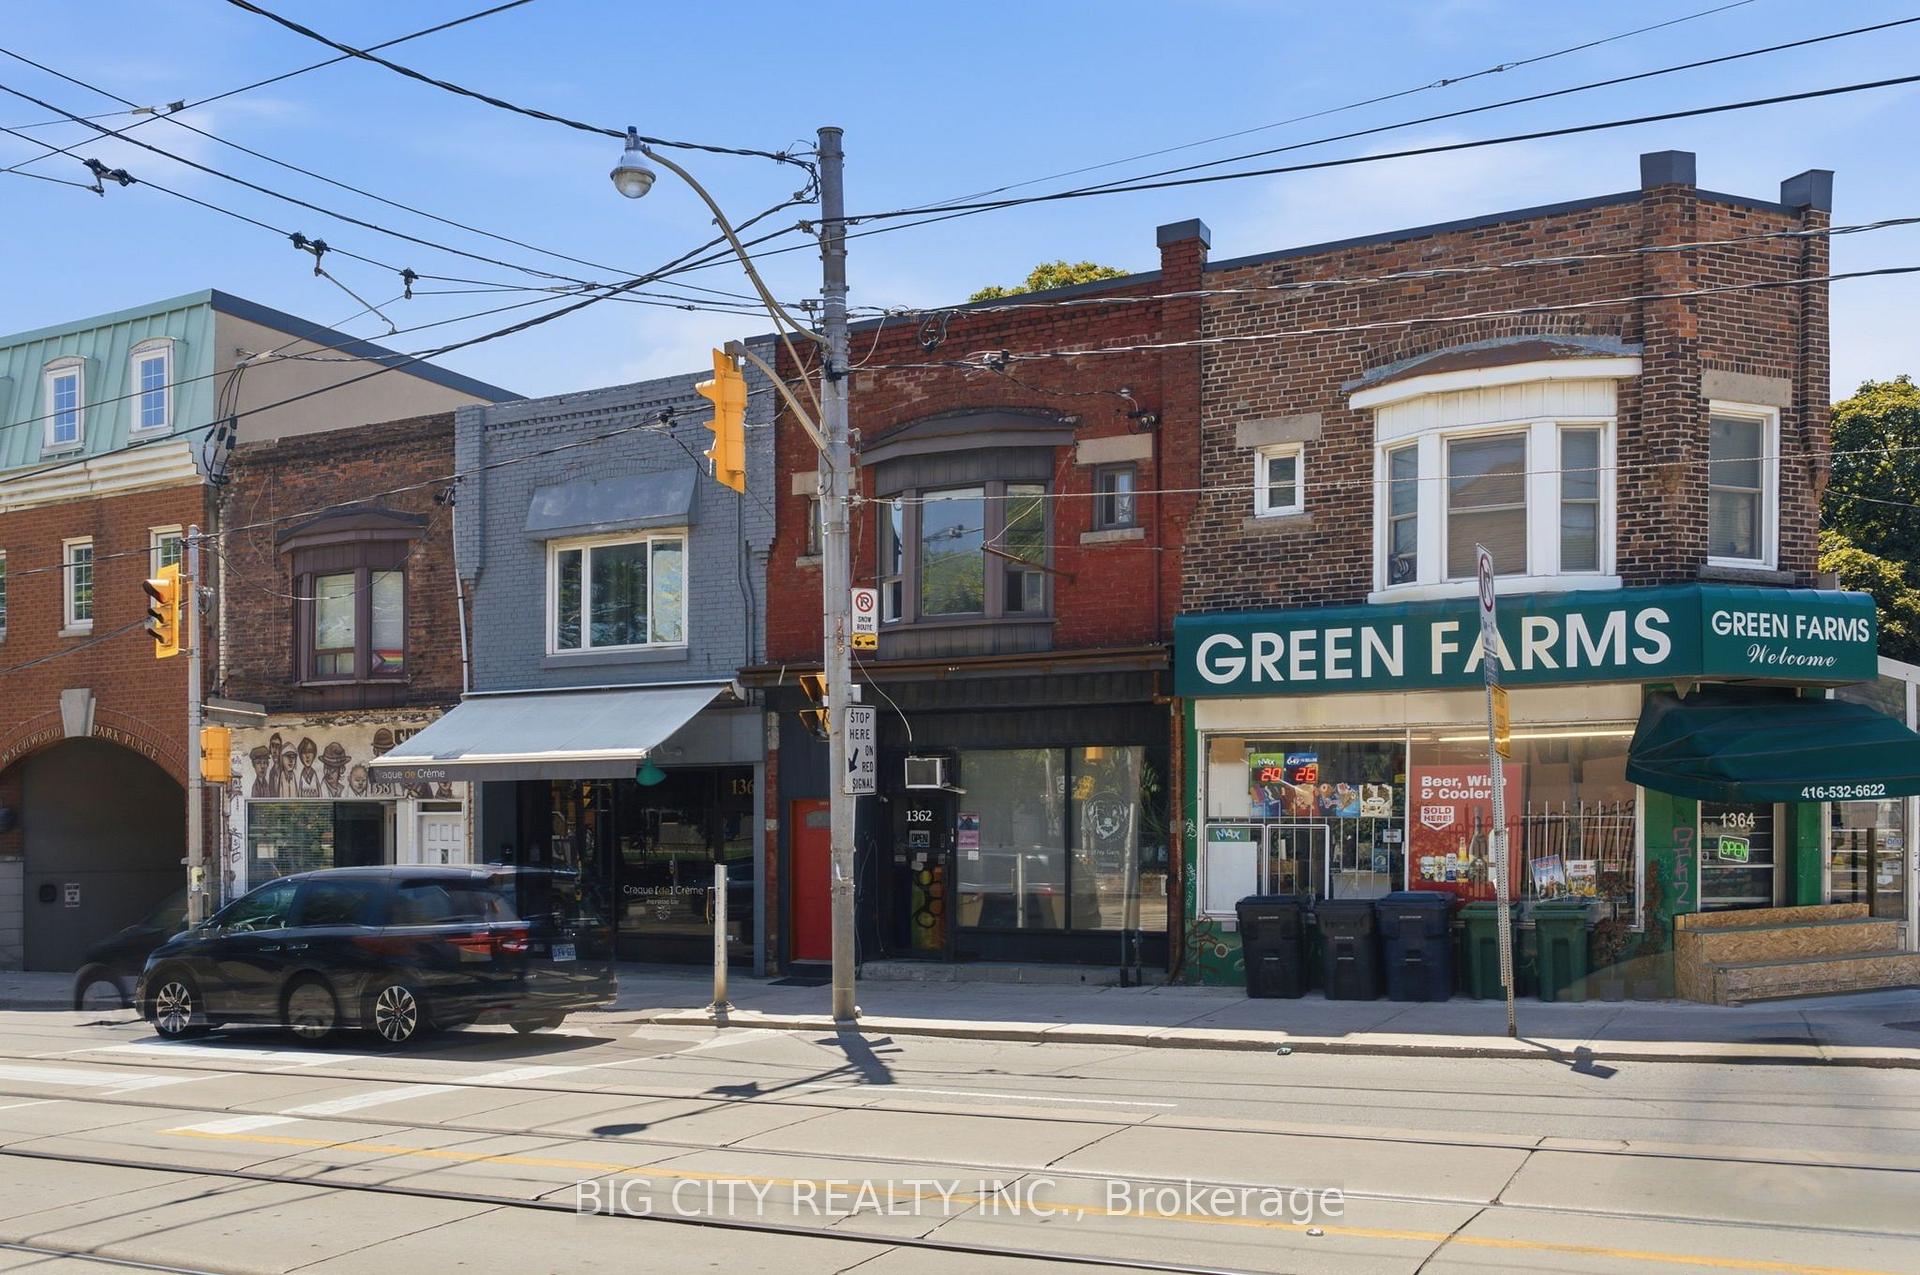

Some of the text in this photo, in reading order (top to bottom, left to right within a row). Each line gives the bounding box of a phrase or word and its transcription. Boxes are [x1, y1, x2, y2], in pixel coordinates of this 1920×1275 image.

[1711, 610, 1870, 642] GREEN FARMS
[1196, 624, 1404, 684] GREEN
[1430, 607, 1672, 674] FARMS
[1747, 643, 1838, 667] Welcome
[850, 712, 870, 723] STOP
[850, 729, 870, 740] HERE
[1, 725, 158, 763] WYCHWOOD PARK PLACE
[865, 745, 873, 756] ON
[862, 761, 873, 772] RED
[1261, 768, 1281, 781] 20
[1296, 767, 1315, 781] 26
[852, 778, 874, 789] SIGNAL
[1421, 776, 1462, 788] Beer,
[1421, 788, 1494, 800] & Cooler
[1801, 783, 1886, 798] 416-532-6622
[906, 810, 932, 822] 1362
[1423, 807, 1452, 815] SOLD
[1720, 812, 1755, 828] 1364
[1721, 840, 1747, 857] OPEN
